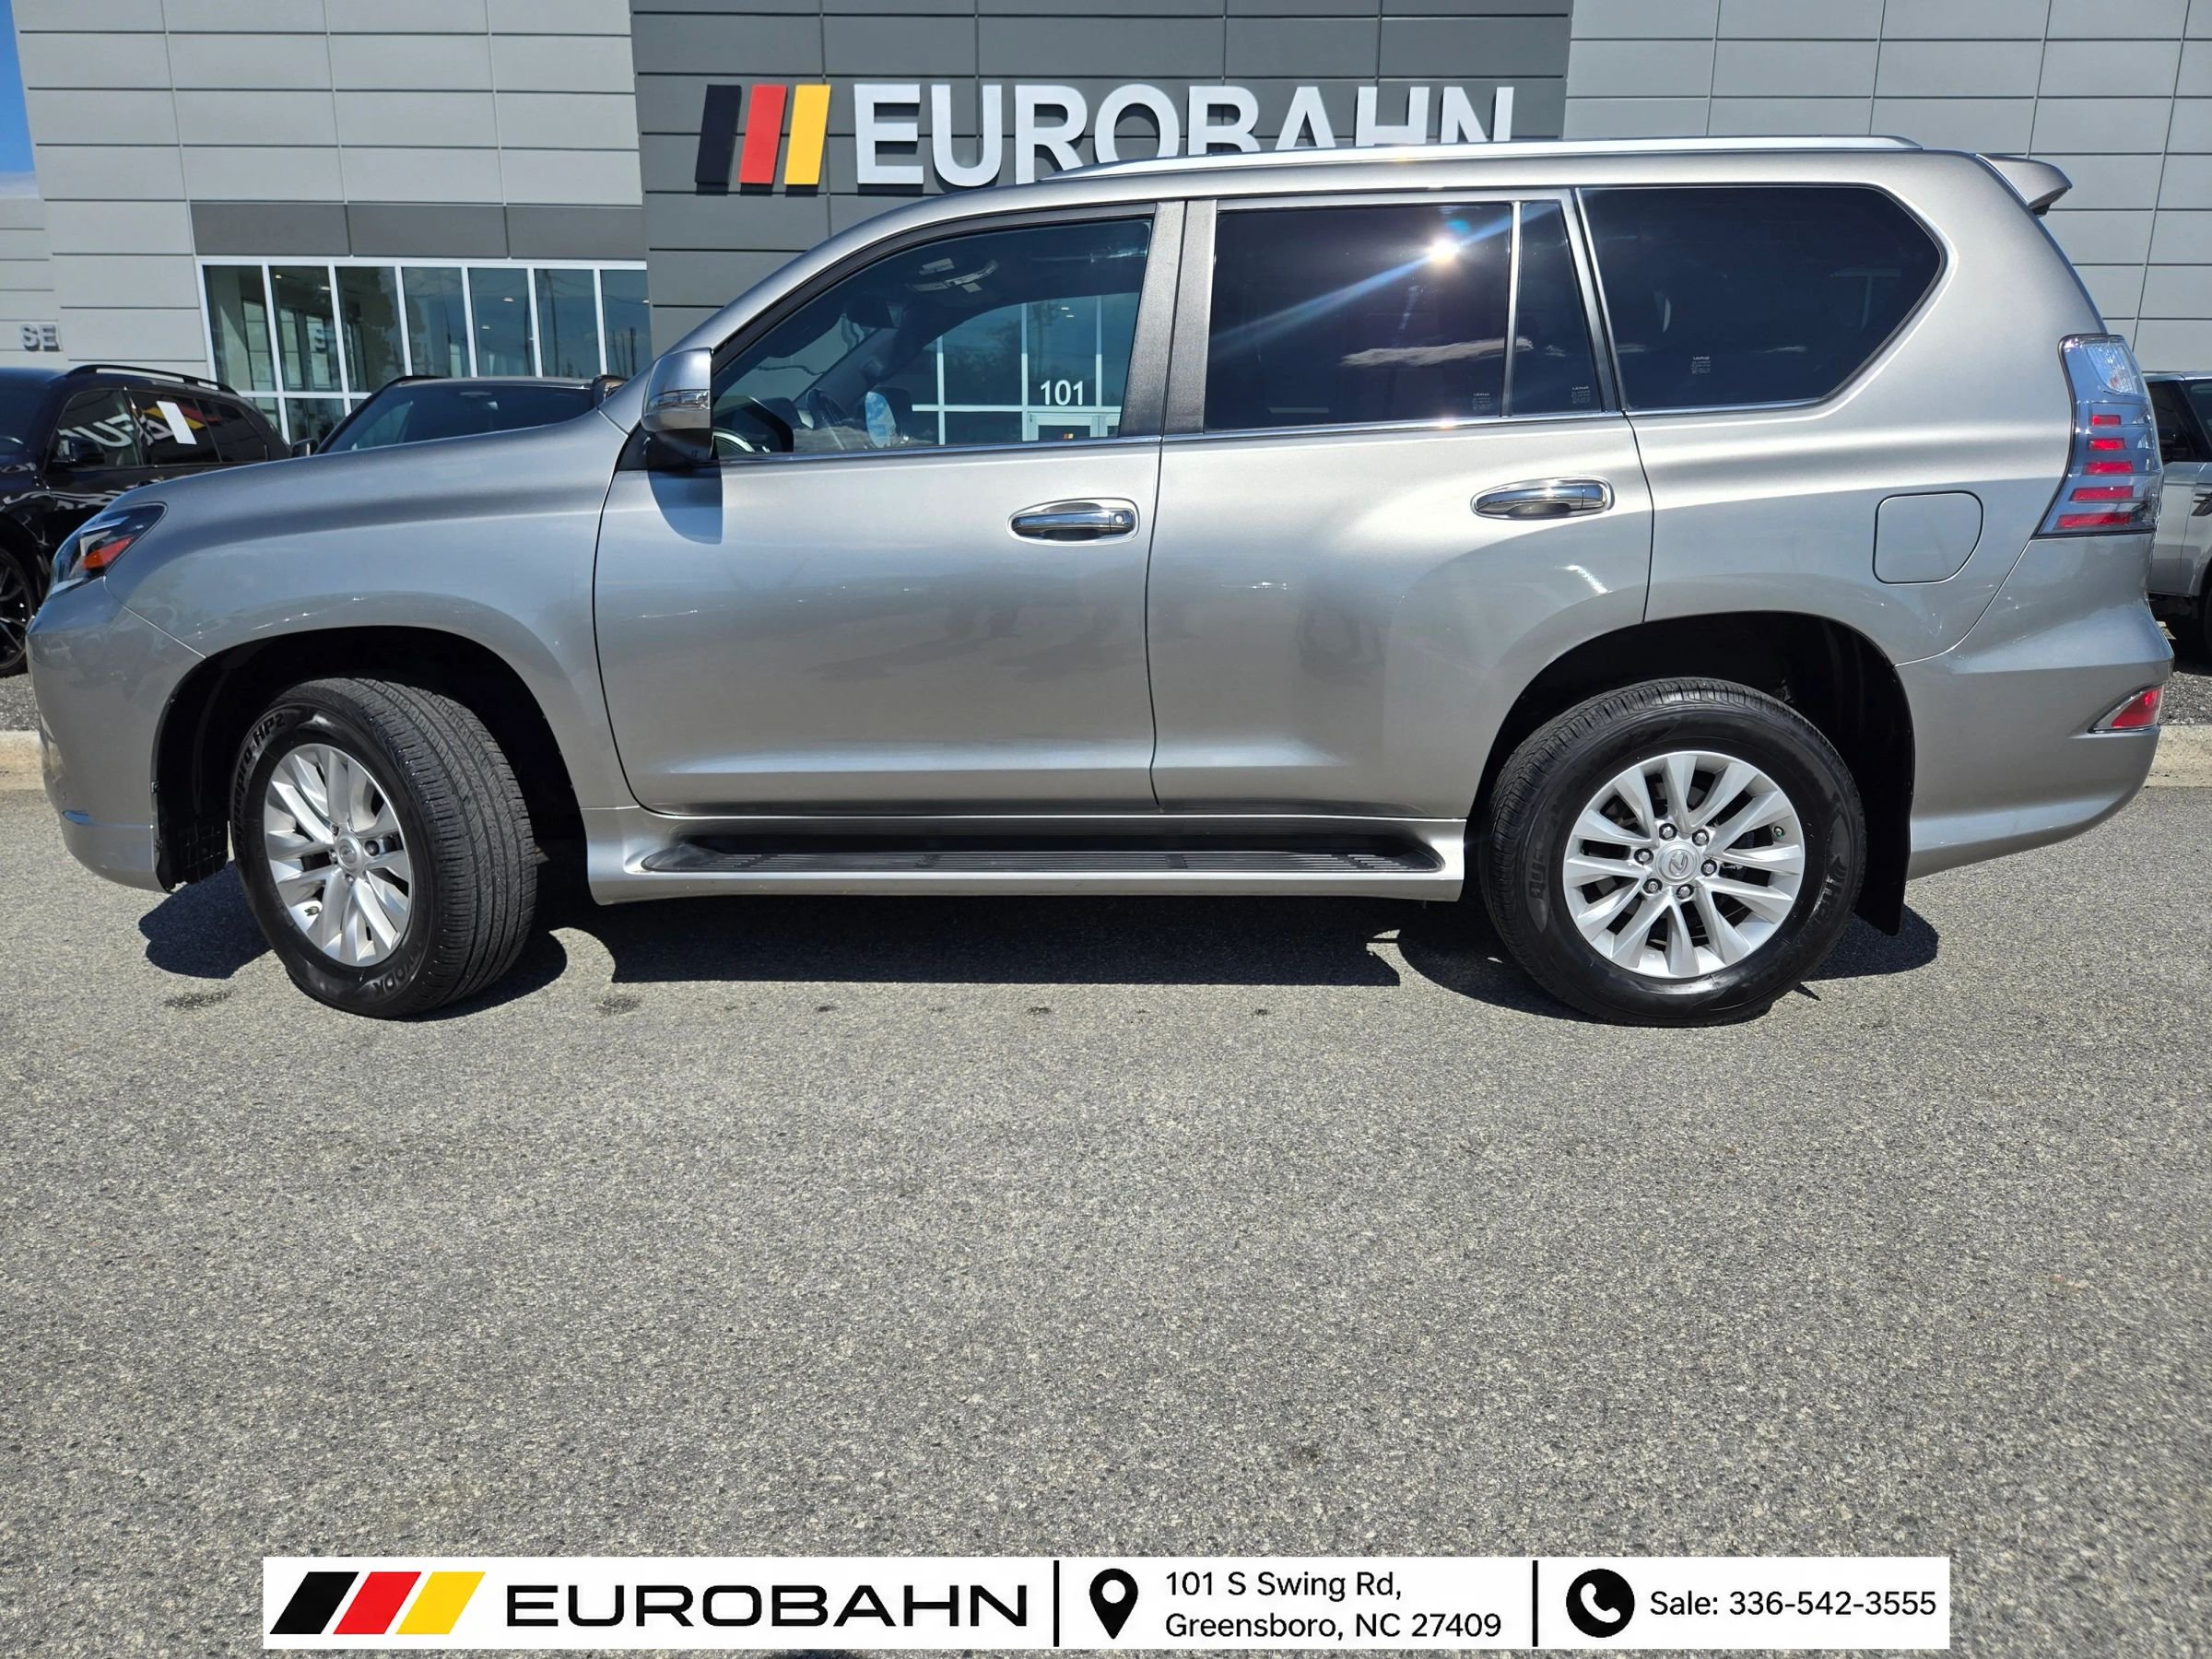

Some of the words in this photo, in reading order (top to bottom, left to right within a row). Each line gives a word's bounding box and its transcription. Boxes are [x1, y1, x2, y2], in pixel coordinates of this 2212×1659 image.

[854, 84, 1515, 185] EUROBAHN
[1040, 379, 1084, 406] 101
[253, 712, 287, 747] HP2
